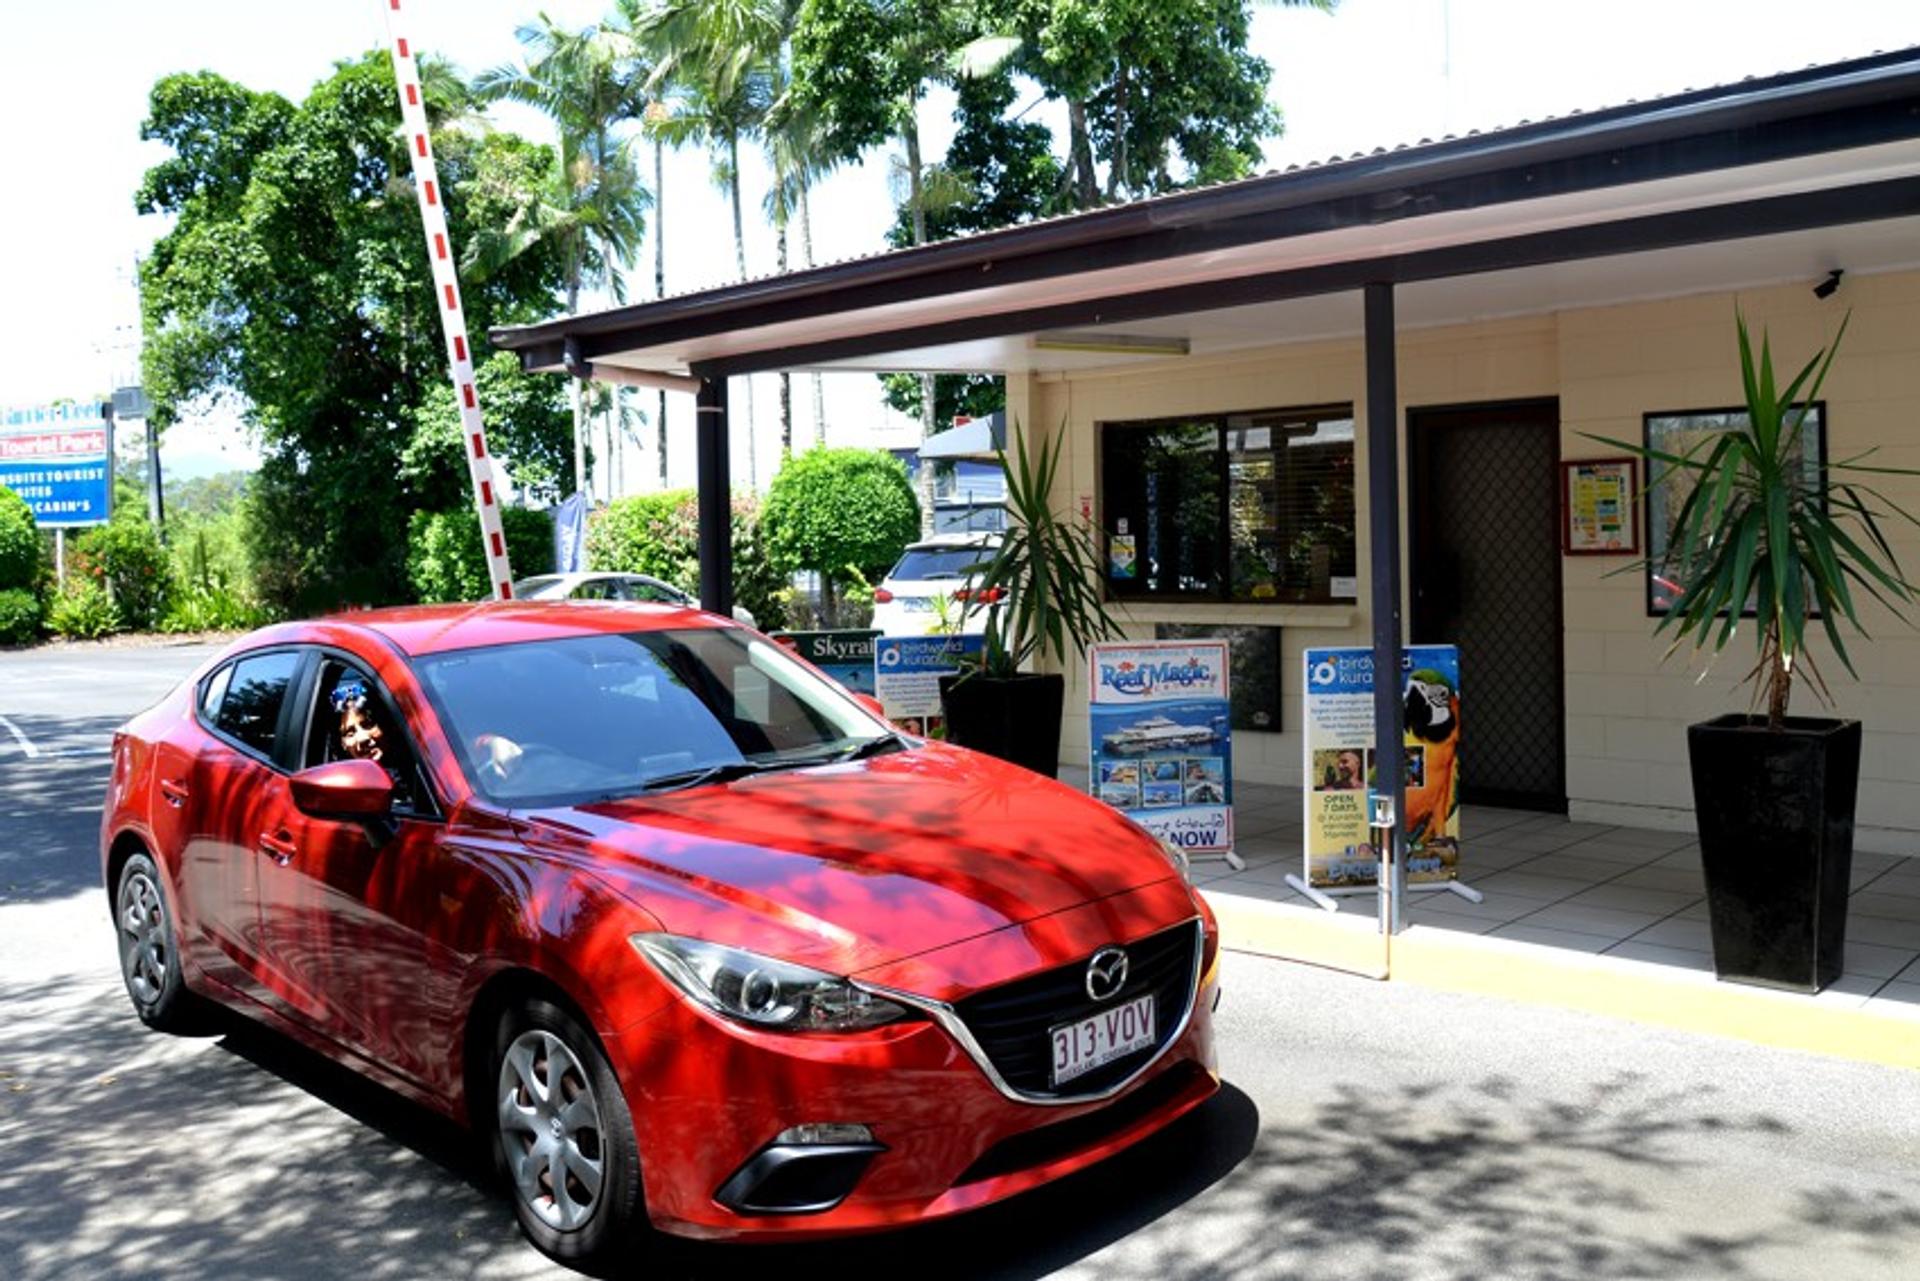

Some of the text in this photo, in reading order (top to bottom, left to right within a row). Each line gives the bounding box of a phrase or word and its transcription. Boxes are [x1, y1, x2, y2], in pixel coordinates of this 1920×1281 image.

[46, 468, 104, 481] TOURIST
[36, 500, 91, 513] CABIN'S
[813, 635, 875, 659] Skyrai
[1100, 661, 1210, 694] Reef Magic
[1324, 794, 1355, 803] OPEN
[1331, 803, 1359, 812] DAYS
[1170, 830, 1217, 846] NOW
